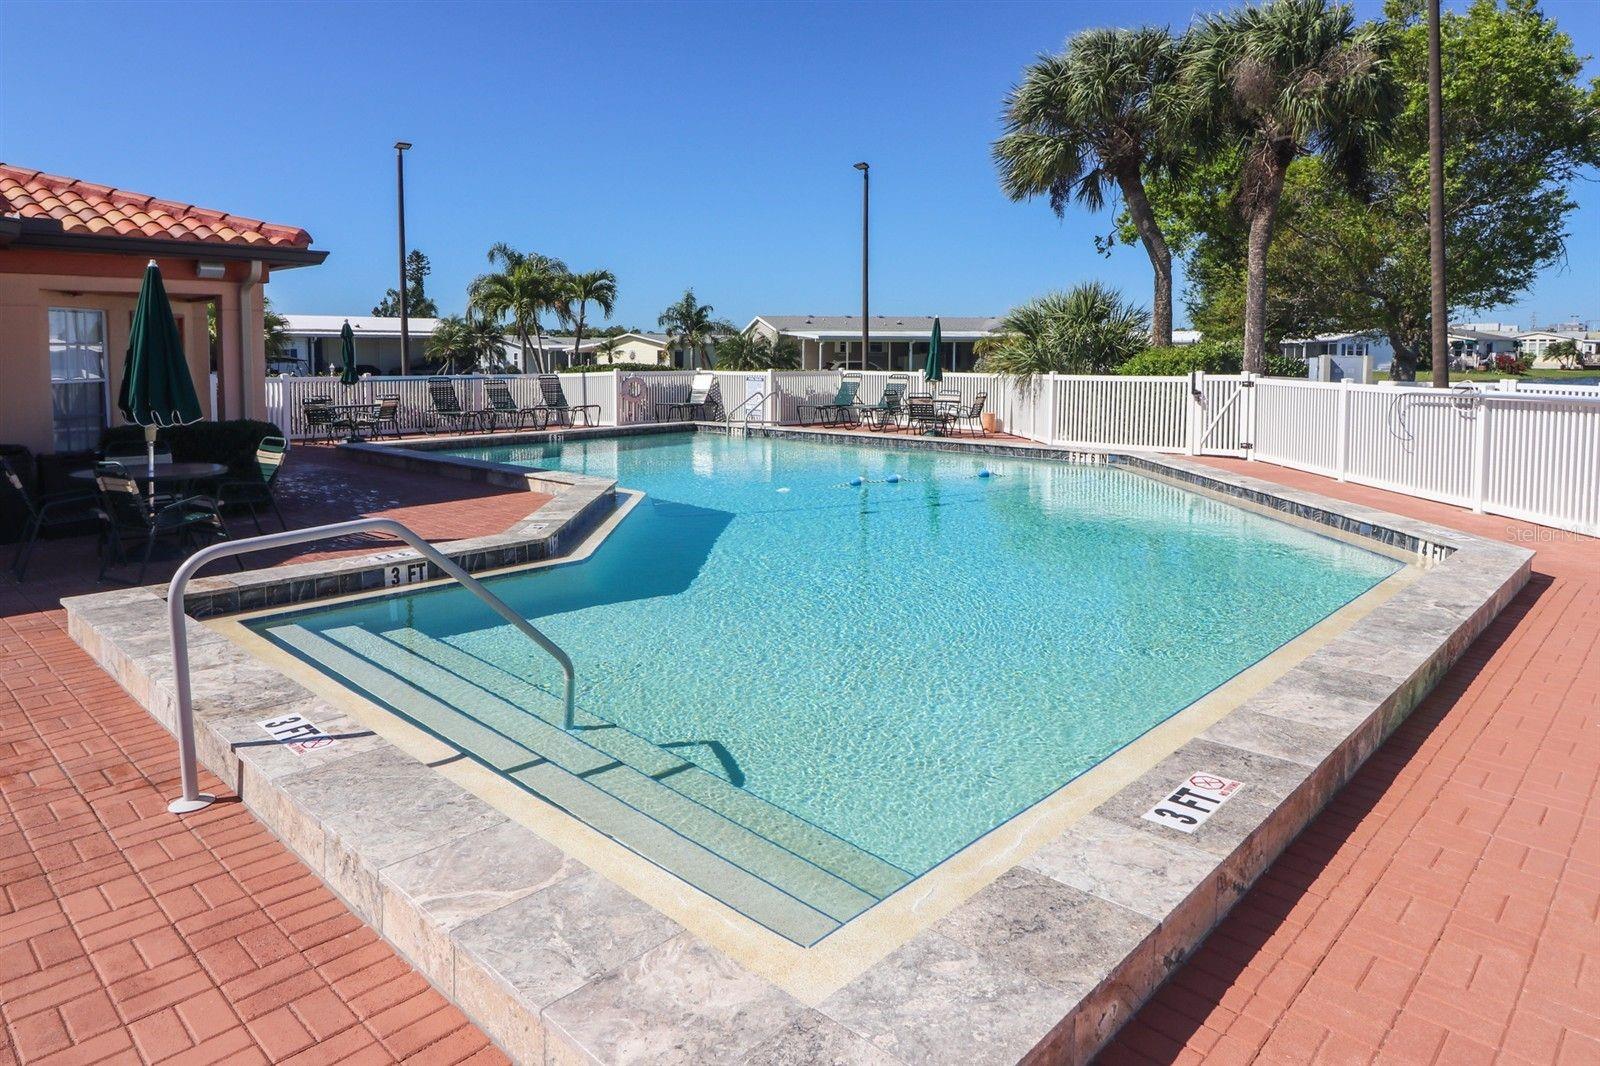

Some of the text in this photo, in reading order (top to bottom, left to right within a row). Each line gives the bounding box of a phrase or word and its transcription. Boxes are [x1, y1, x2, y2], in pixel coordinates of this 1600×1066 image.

[1079, 452, 1088, 463] FT
[1099, 453, 1107, 464] IN
[1422, 541, 1445, 561] 4 FT
[391, 562, 426, 585] 3 FT
[264, 717, 322, 742] 3 FT
[1168, 787, 1221, 813] FT
[1154, 808, 1198, 825] 3
